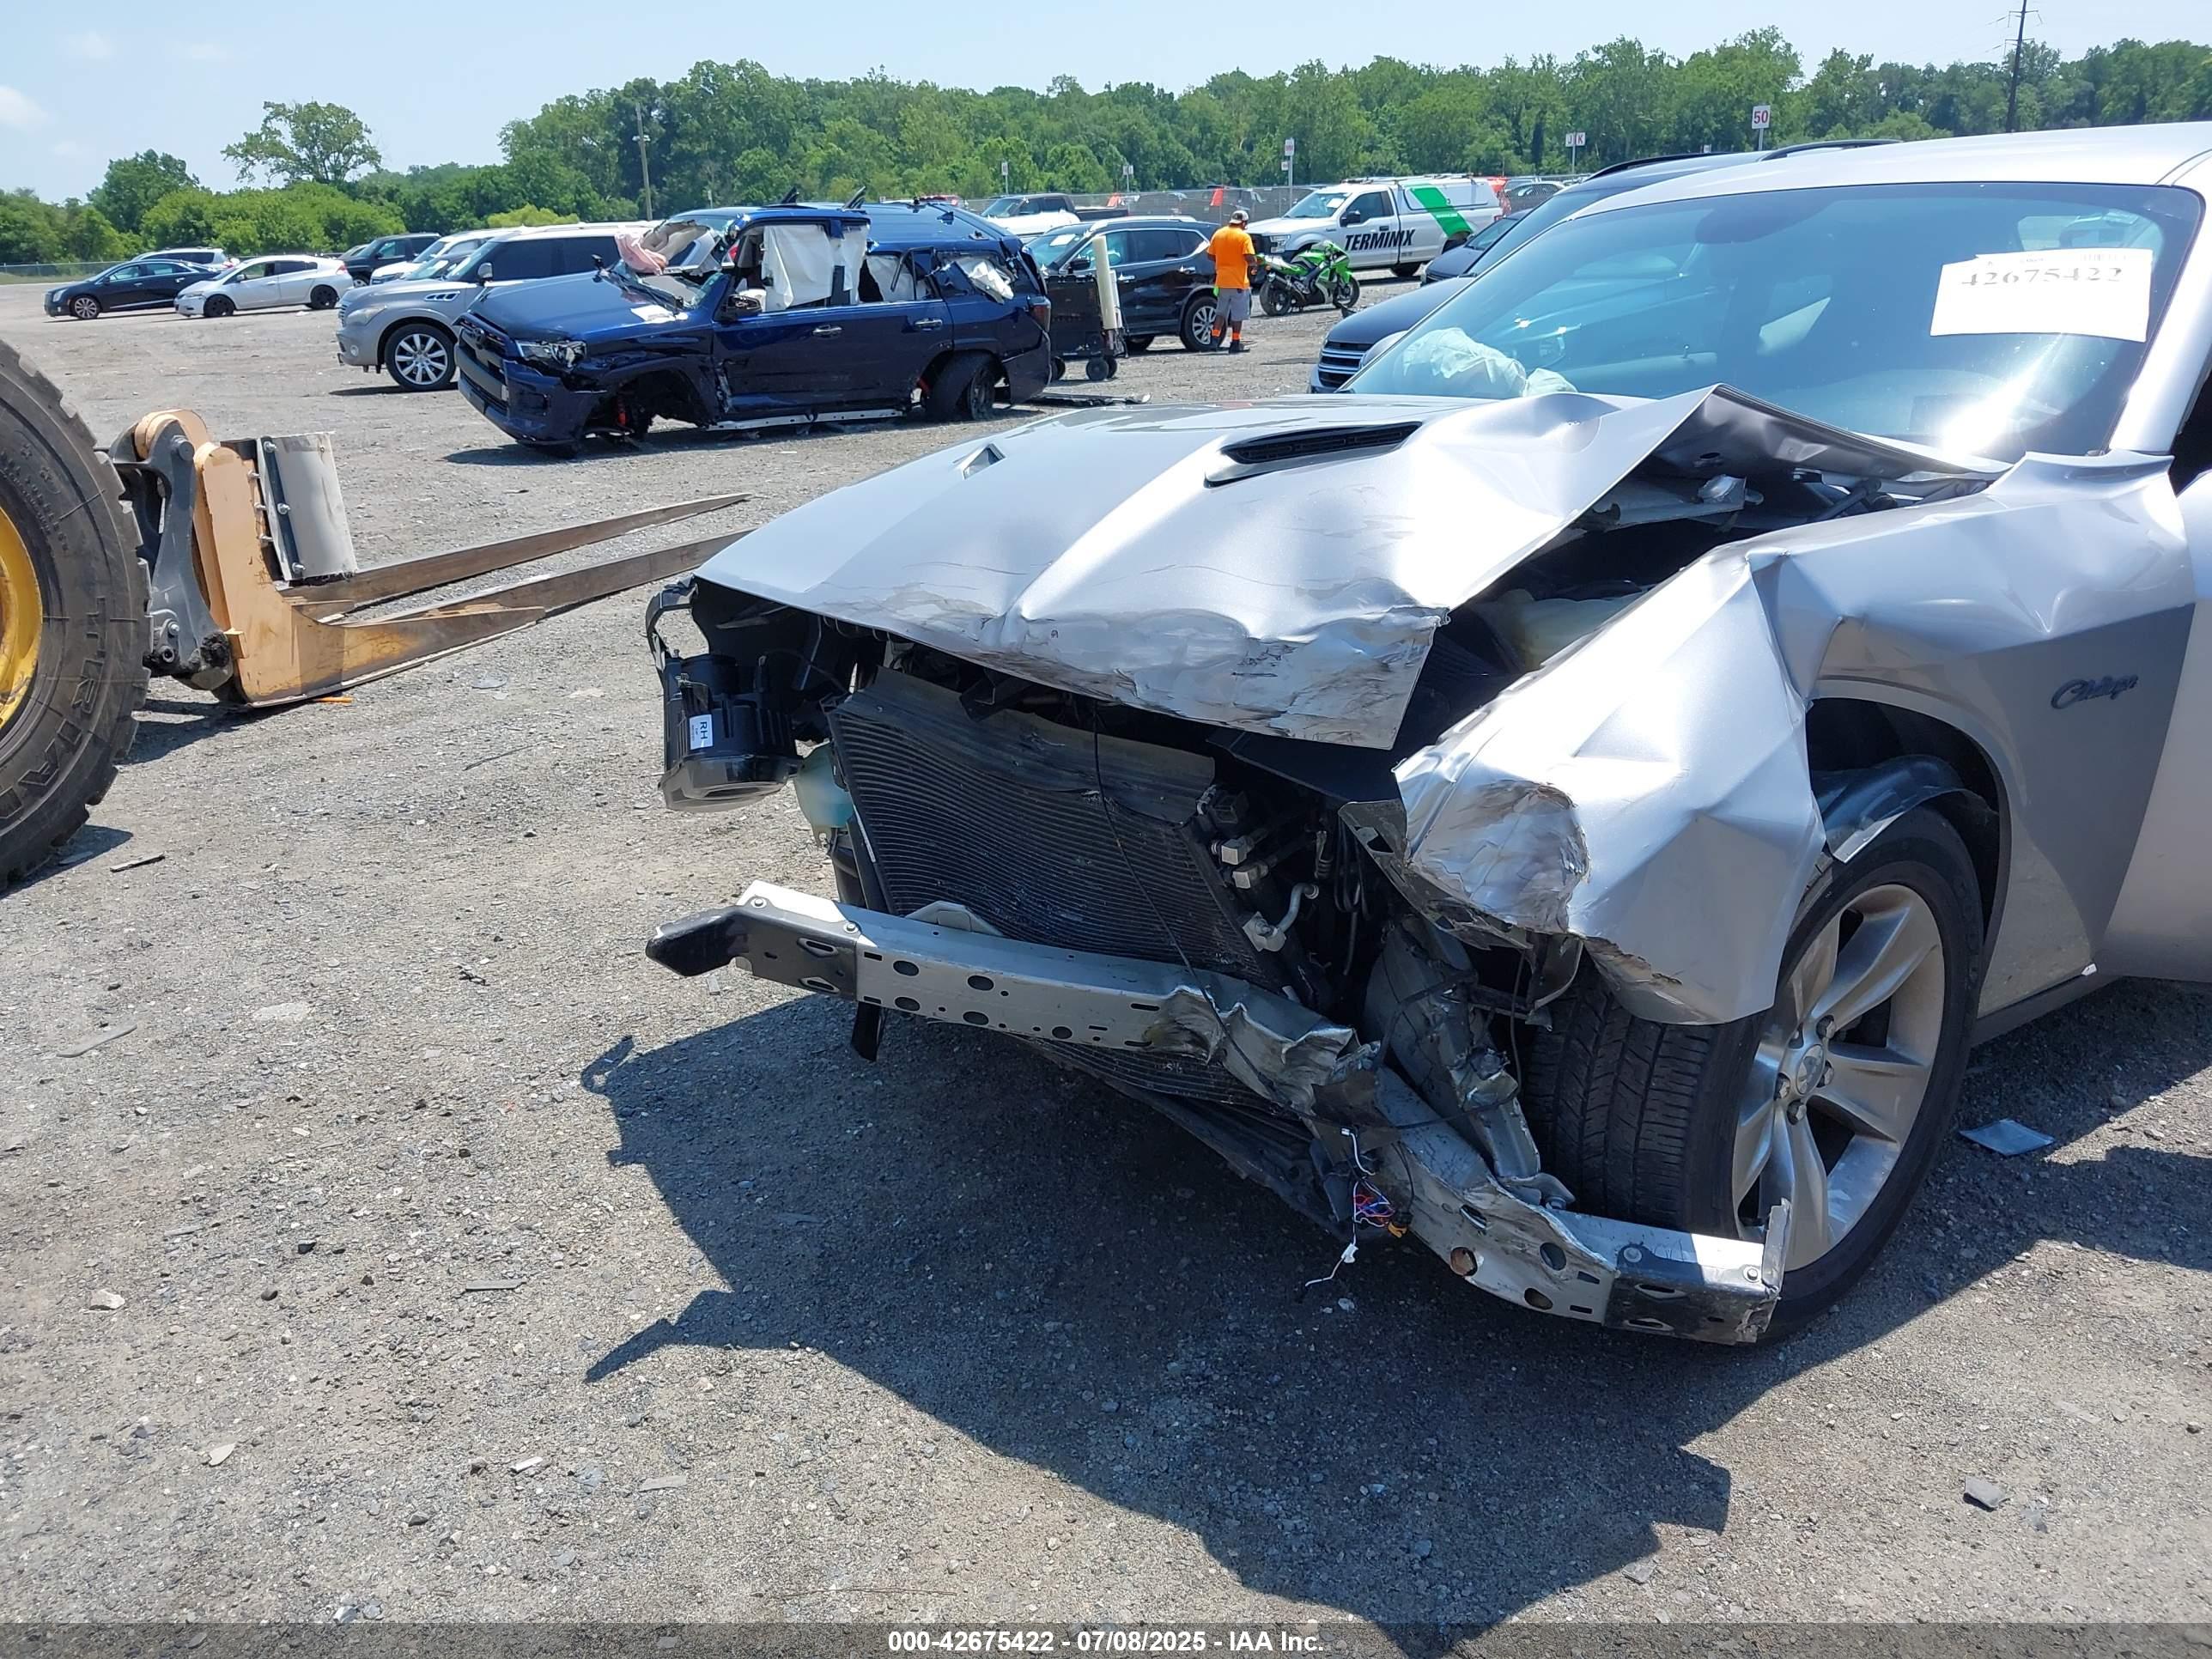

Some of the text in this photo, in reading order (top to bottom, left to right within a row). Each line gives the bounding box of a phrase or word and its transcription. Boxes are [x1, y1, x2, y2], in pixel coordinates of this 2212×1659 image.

[1753, 109, 1769, 125] 50
[1577, 133, 1584, 144] K
[1960, 267, 2123, 286] 42675422
[700, 721, 708, 740] RH
